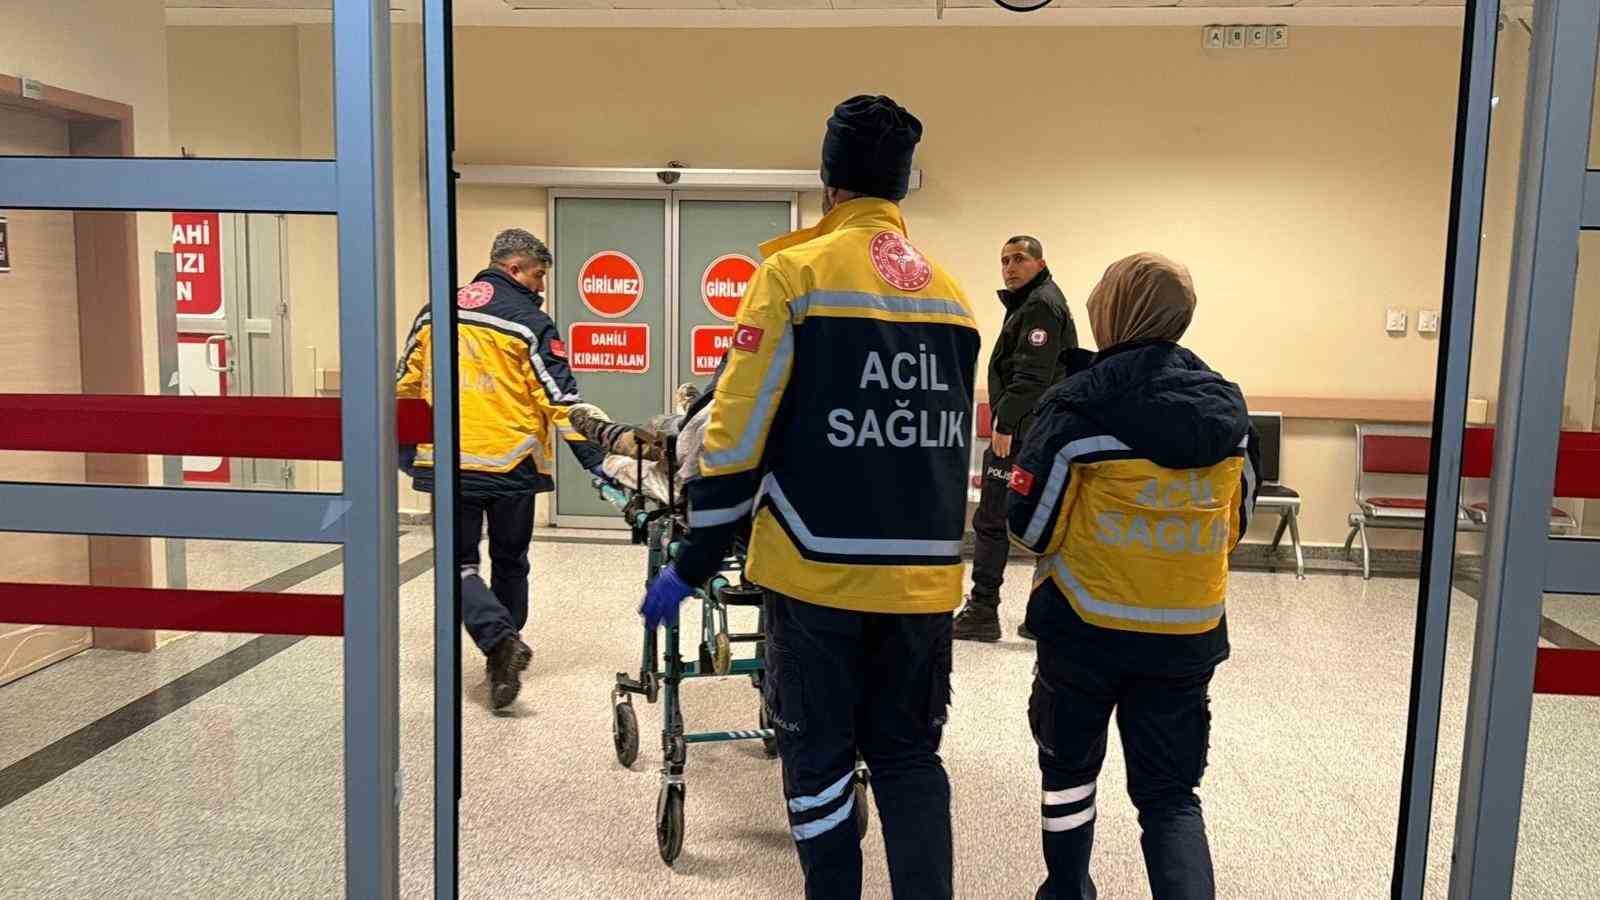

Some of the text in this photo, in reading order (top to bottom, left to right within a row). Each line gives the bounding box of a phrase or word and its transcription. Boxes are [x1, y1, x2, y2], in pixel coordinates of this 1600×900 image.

[583, 274, 638, 295] GİRİLMEZ
[591, 330, 628, 347] DAHİLİ
[574, 352, 645, 367] KIRMIZI ALAN
[859, 343, 949, 391] ACİL
[826, 399, 965, 448] SAĞLIK
